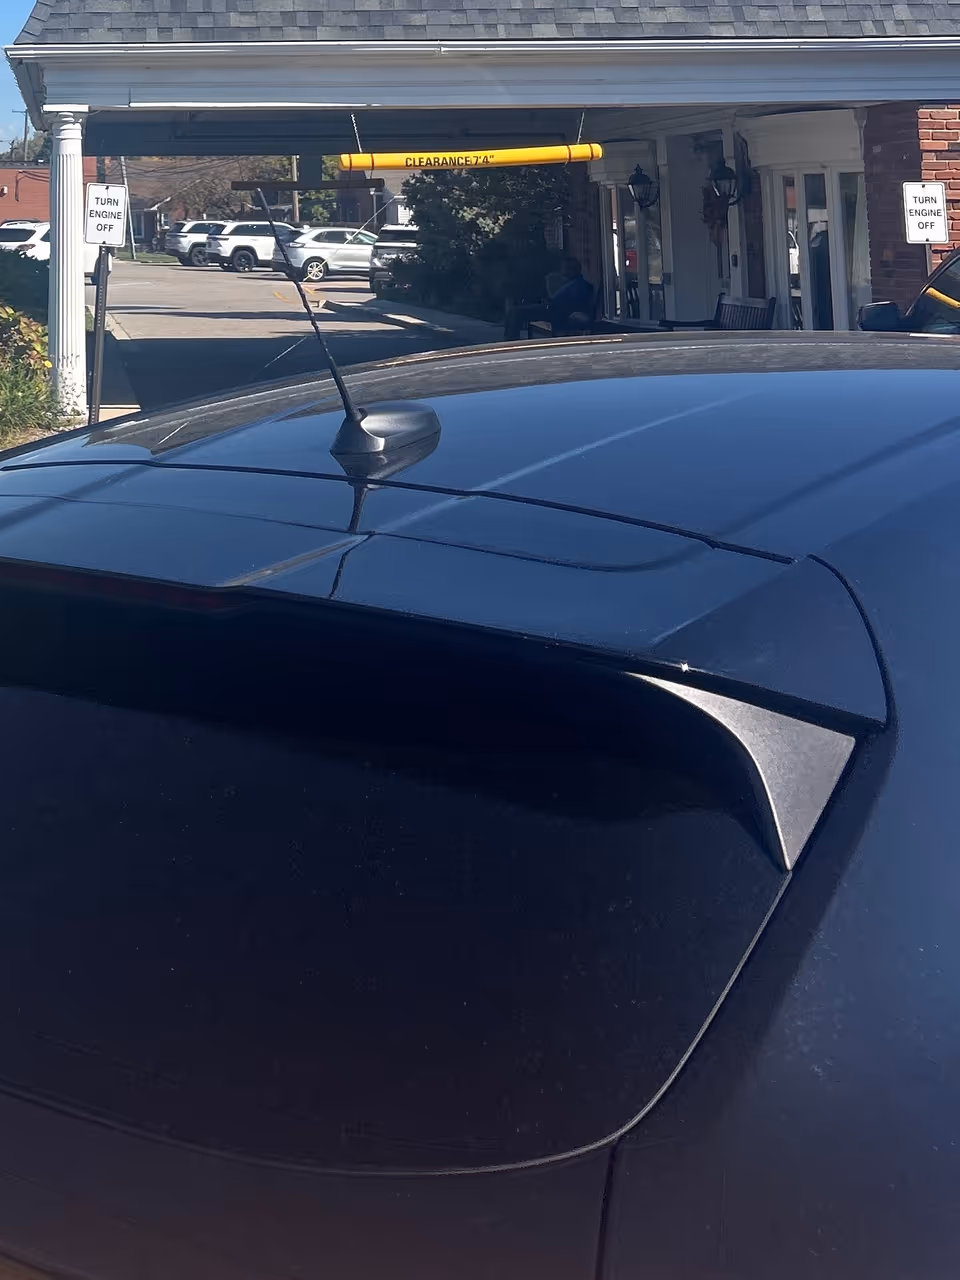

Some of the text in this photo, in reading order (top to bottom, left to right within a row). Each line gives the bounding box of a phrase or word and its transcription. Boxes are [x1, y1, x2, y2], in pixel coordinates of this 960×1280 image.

[405, 156, 470, 167] CLEARANCE
[95, 197, 119, 206] TURN
[913, 196, 937, 204] TURN
[89, 210, 122, 219] ENGINE
[909, 209, 942, 217] ENGINE
[96, 223, 114, 232] OFF
[918, 221, 935, 230] OFF
